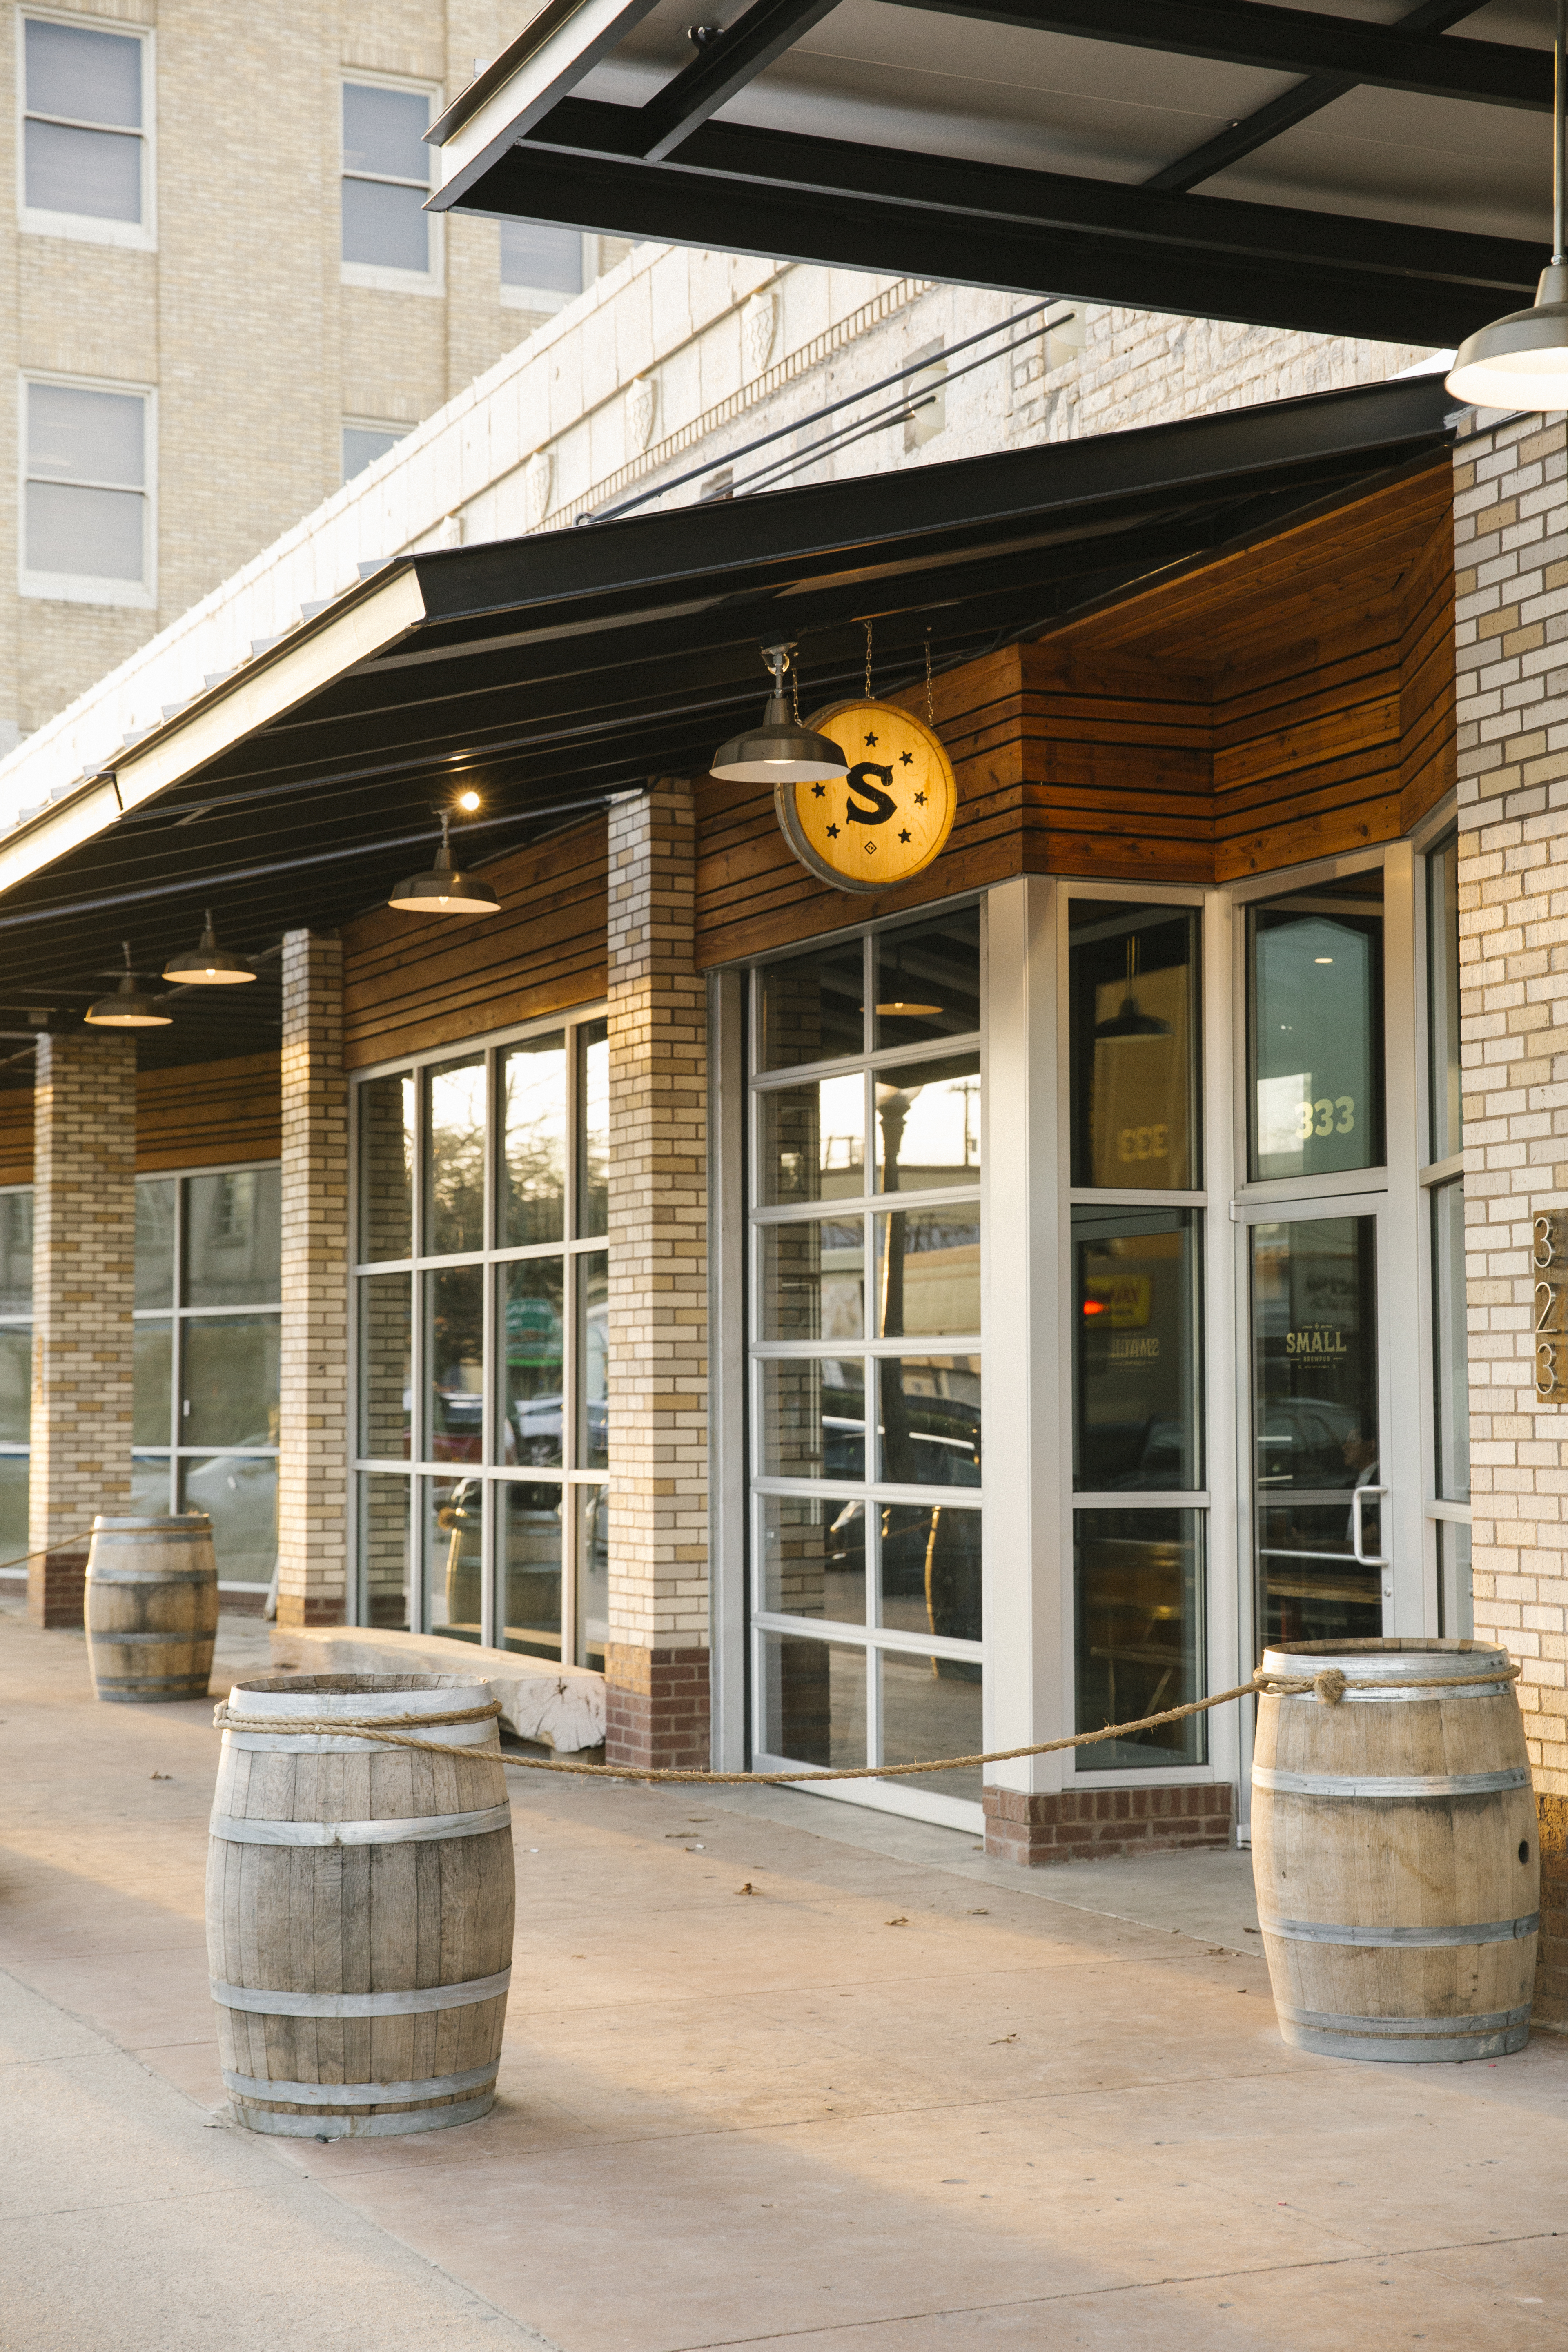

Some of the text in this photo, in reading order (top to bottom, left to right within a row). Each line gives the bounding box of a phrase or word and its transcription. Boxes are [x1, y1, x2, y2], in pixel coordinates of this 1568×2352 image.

[846, 762, 897, 825] S
[1294, 1096, 1354, 1139] 333
[1534, 1217, 1557, 1395] 323
[1287, 1332, 1347, 1353] SMALL
